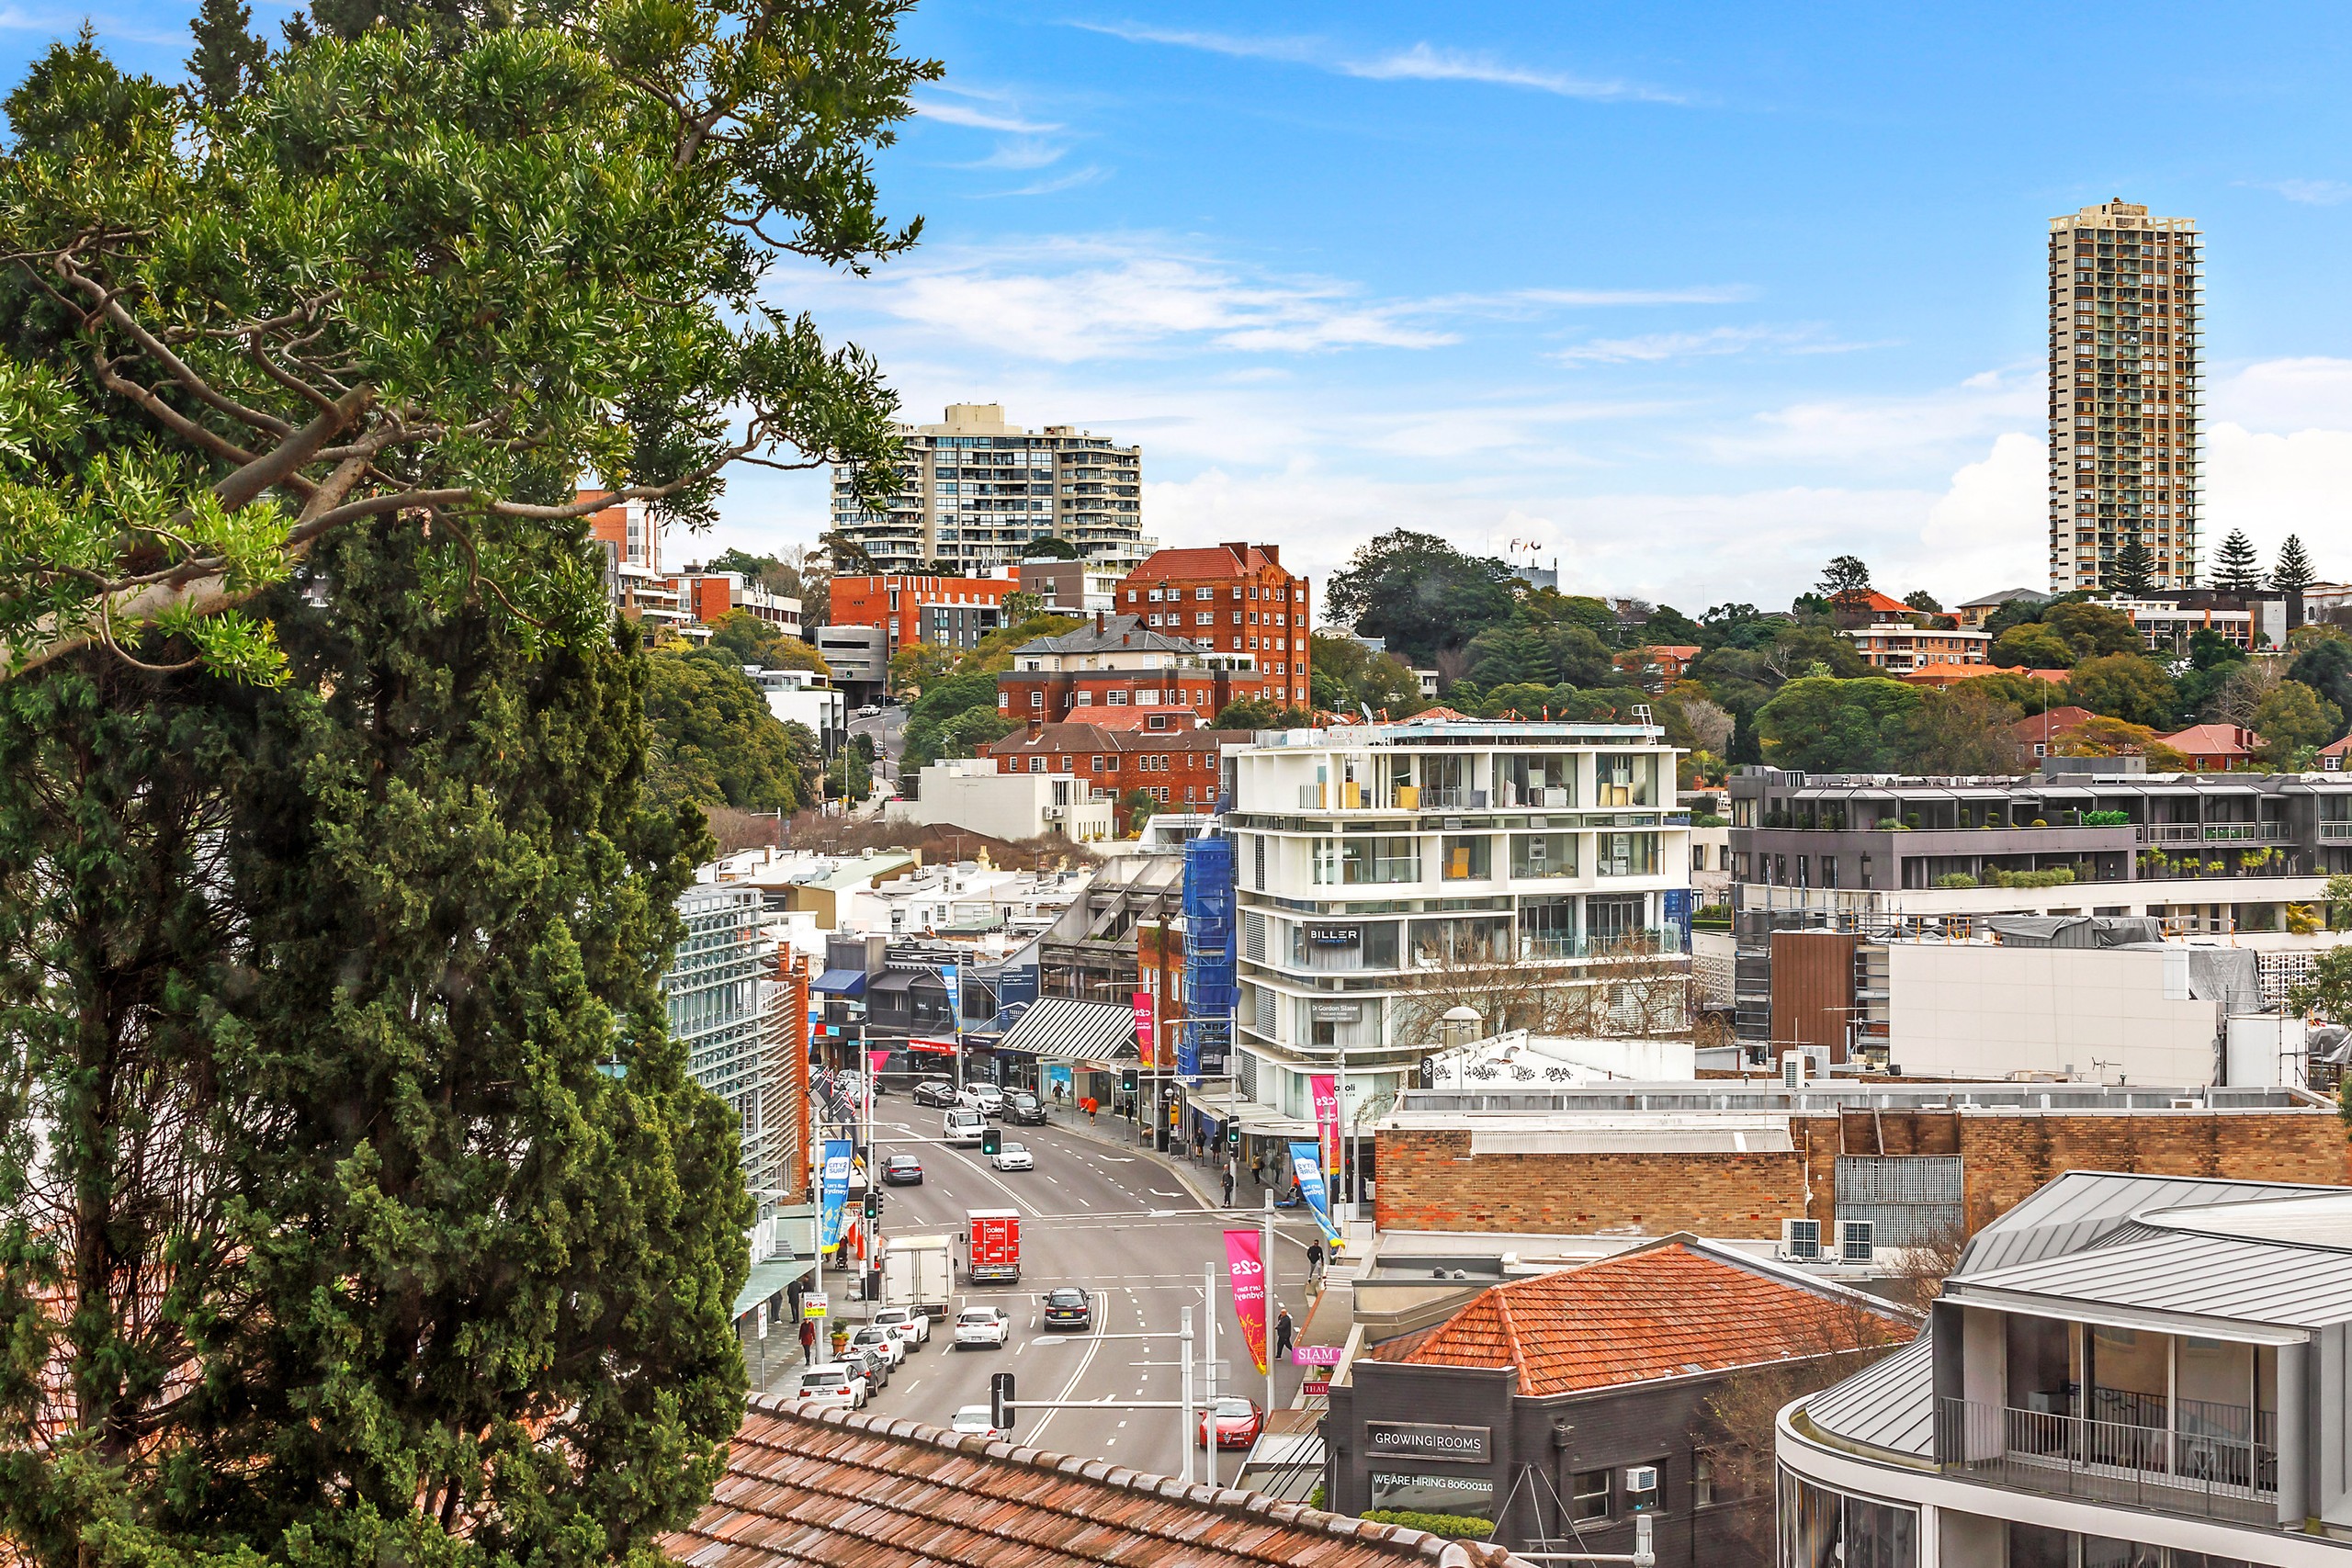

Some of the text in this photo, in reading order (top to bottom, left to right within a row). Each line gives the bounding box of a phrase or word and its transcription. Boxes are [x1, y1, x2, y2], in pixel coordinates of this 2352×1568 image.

[1310, 931, 1357, 939] BILLER
[1298, 1348, 1333, 1359] SIAM
[1373, 1473, 1493, 1492] WE ARE HIRING 80600110
